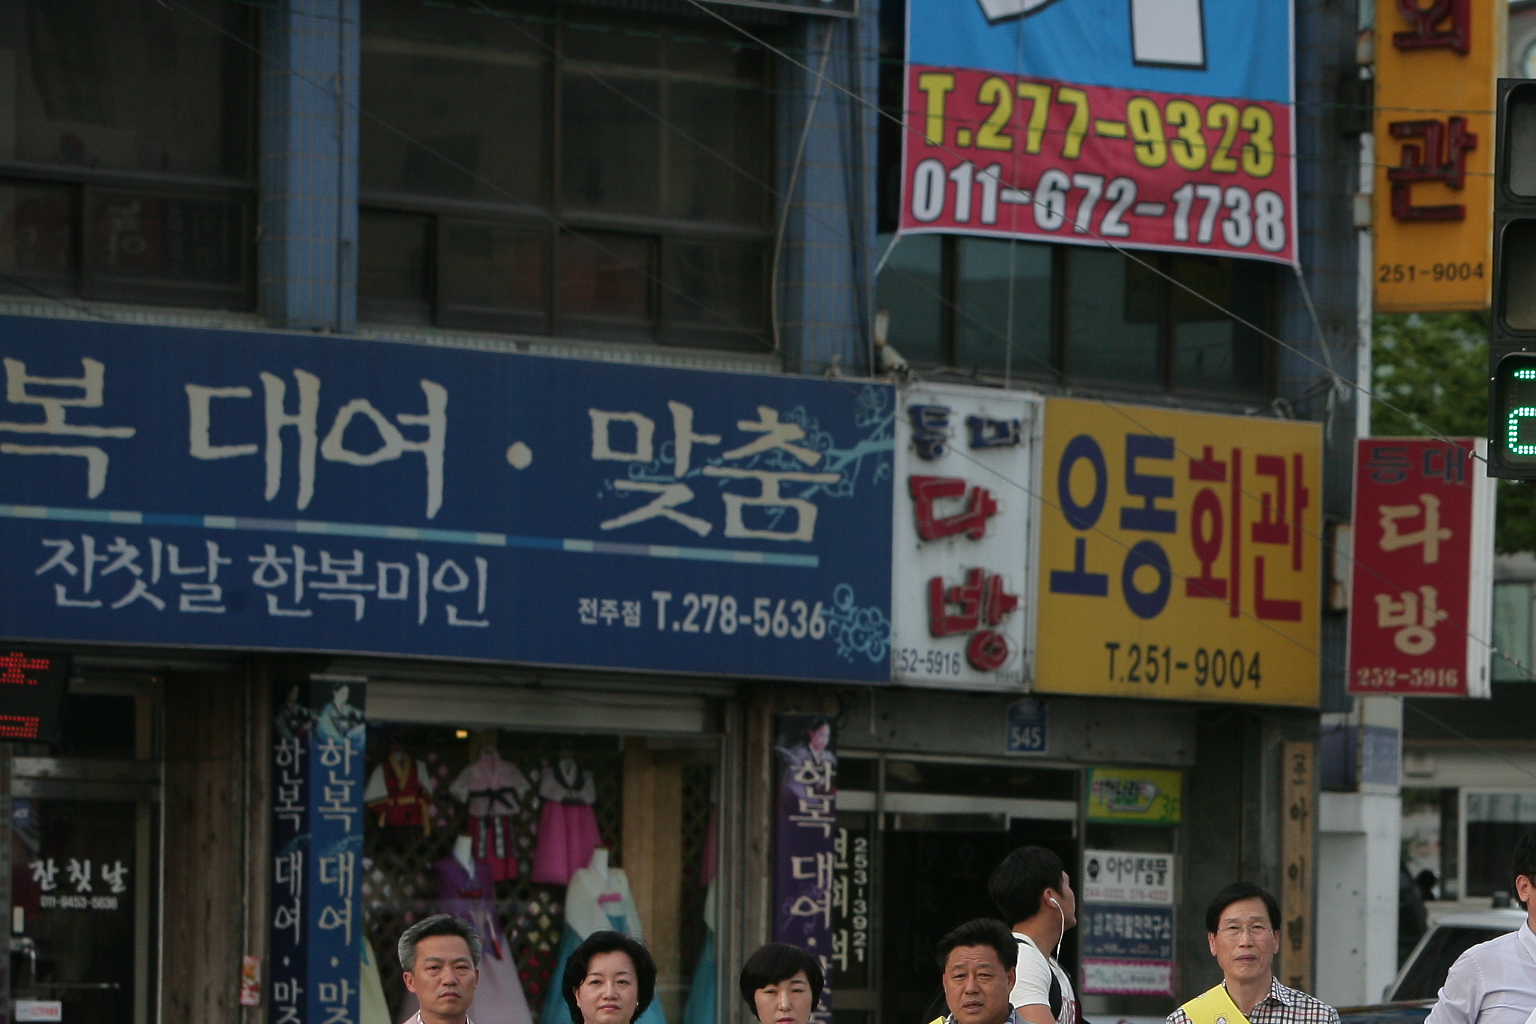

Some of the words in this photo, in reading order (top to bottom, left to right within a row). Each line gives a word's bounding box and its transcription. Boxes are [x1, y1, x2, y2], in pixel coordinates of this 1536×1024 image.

[918, 72, 1275, 178] T.277-9323
[911, 157, 1287, 253] 011-672-1738
[1379, 260, 1484, 284] 251-9004
[0, 356, 136, 500] 복
[185, 367, 448, 519] 대여
[589, 400, 841, 542] 맞춤
[1364, 445, 1467, 486] 등대
[1049, 433, 1309, 622] 오동회관
[1374, 494, 1454, 656] 다방
[35, 533, 232, 615] 잔칫날
[249, 543, 490, 628] 한복미인
[652, 591, 827, 641] T.278-5636
[1104, 642, 1263, 690] T.251-9004
[1356, 667, 1459, 689] 252-5916
[1010, 726, 1042, 748] 545
[275, 737, 305, 833] 한복
[317, 737, 359, 833] 한복
[789, 759, 837, 838] 한복
[29, 857, 129, 893] 잔칫날
[274, 850, 304, 946] 대여
[317, 850, 356, 947] 대여
[789, 851, 834, 931] 대여
[851, 837, 869, 963] 253-3921
